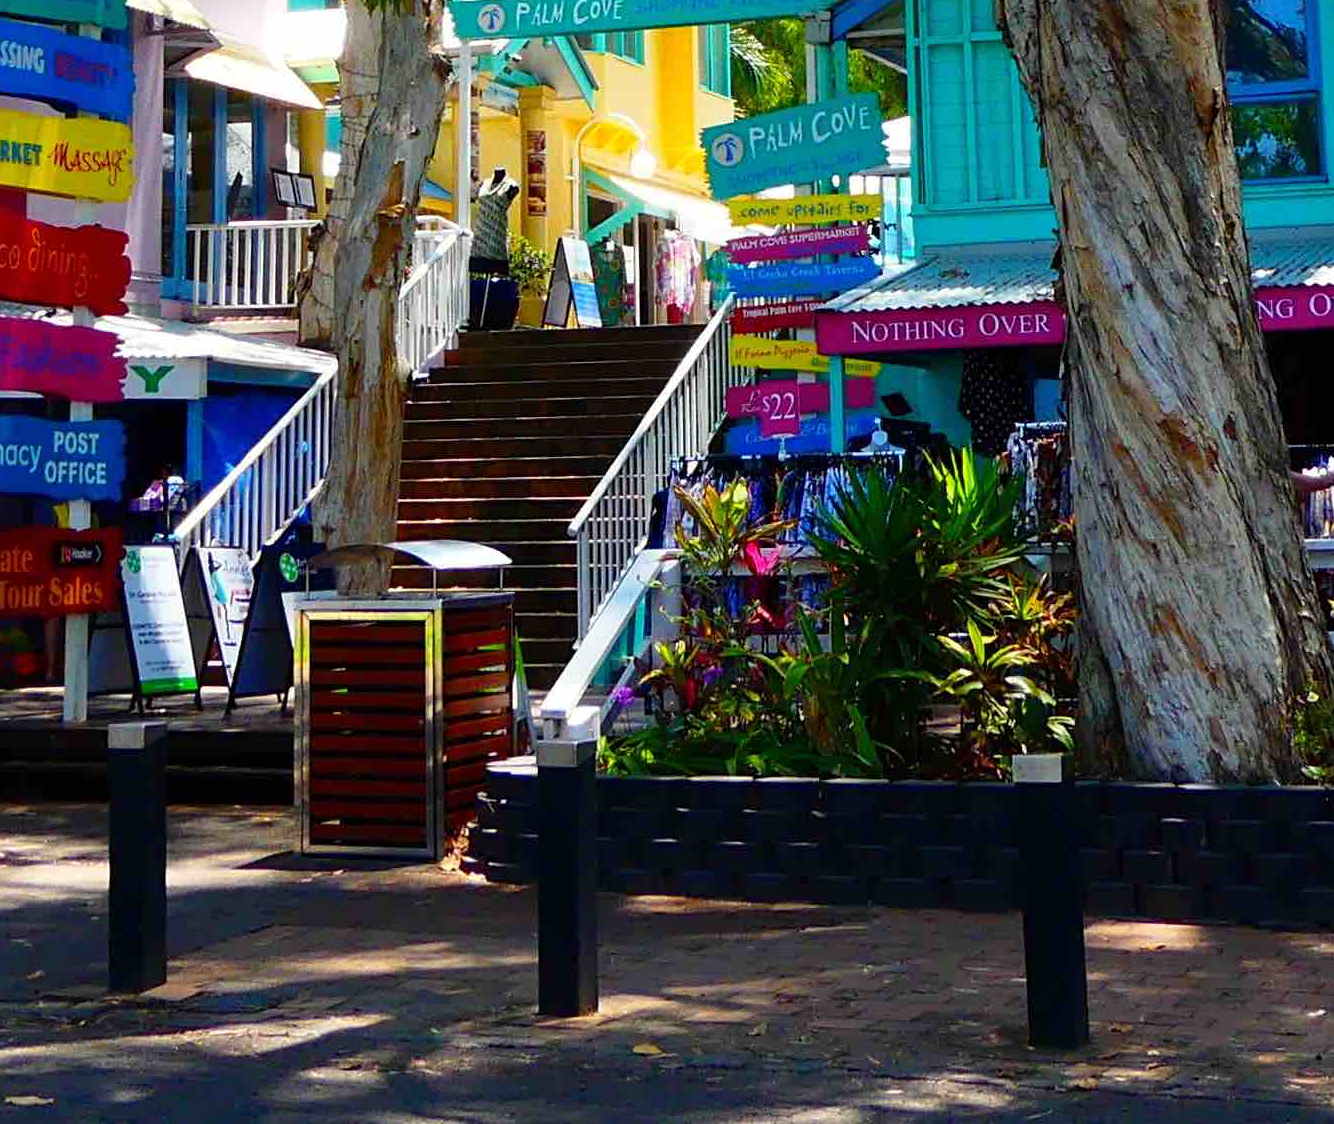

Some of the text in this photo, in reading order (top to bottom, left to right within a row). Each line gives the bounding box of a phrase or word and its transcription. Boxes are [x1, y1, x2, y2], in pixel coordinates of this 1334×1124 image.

[515, 1, 564, 29] PALM
[748, 102, 871, 159] PALM COVE
[851, 313, 1051, 344] NOTHING OVER
[762, 392, 796, 420] $22
[53, 430, 100, 455] POST
[44, 460, 108, 485] OFFICE
[48, 576, 104, 606] Sales
